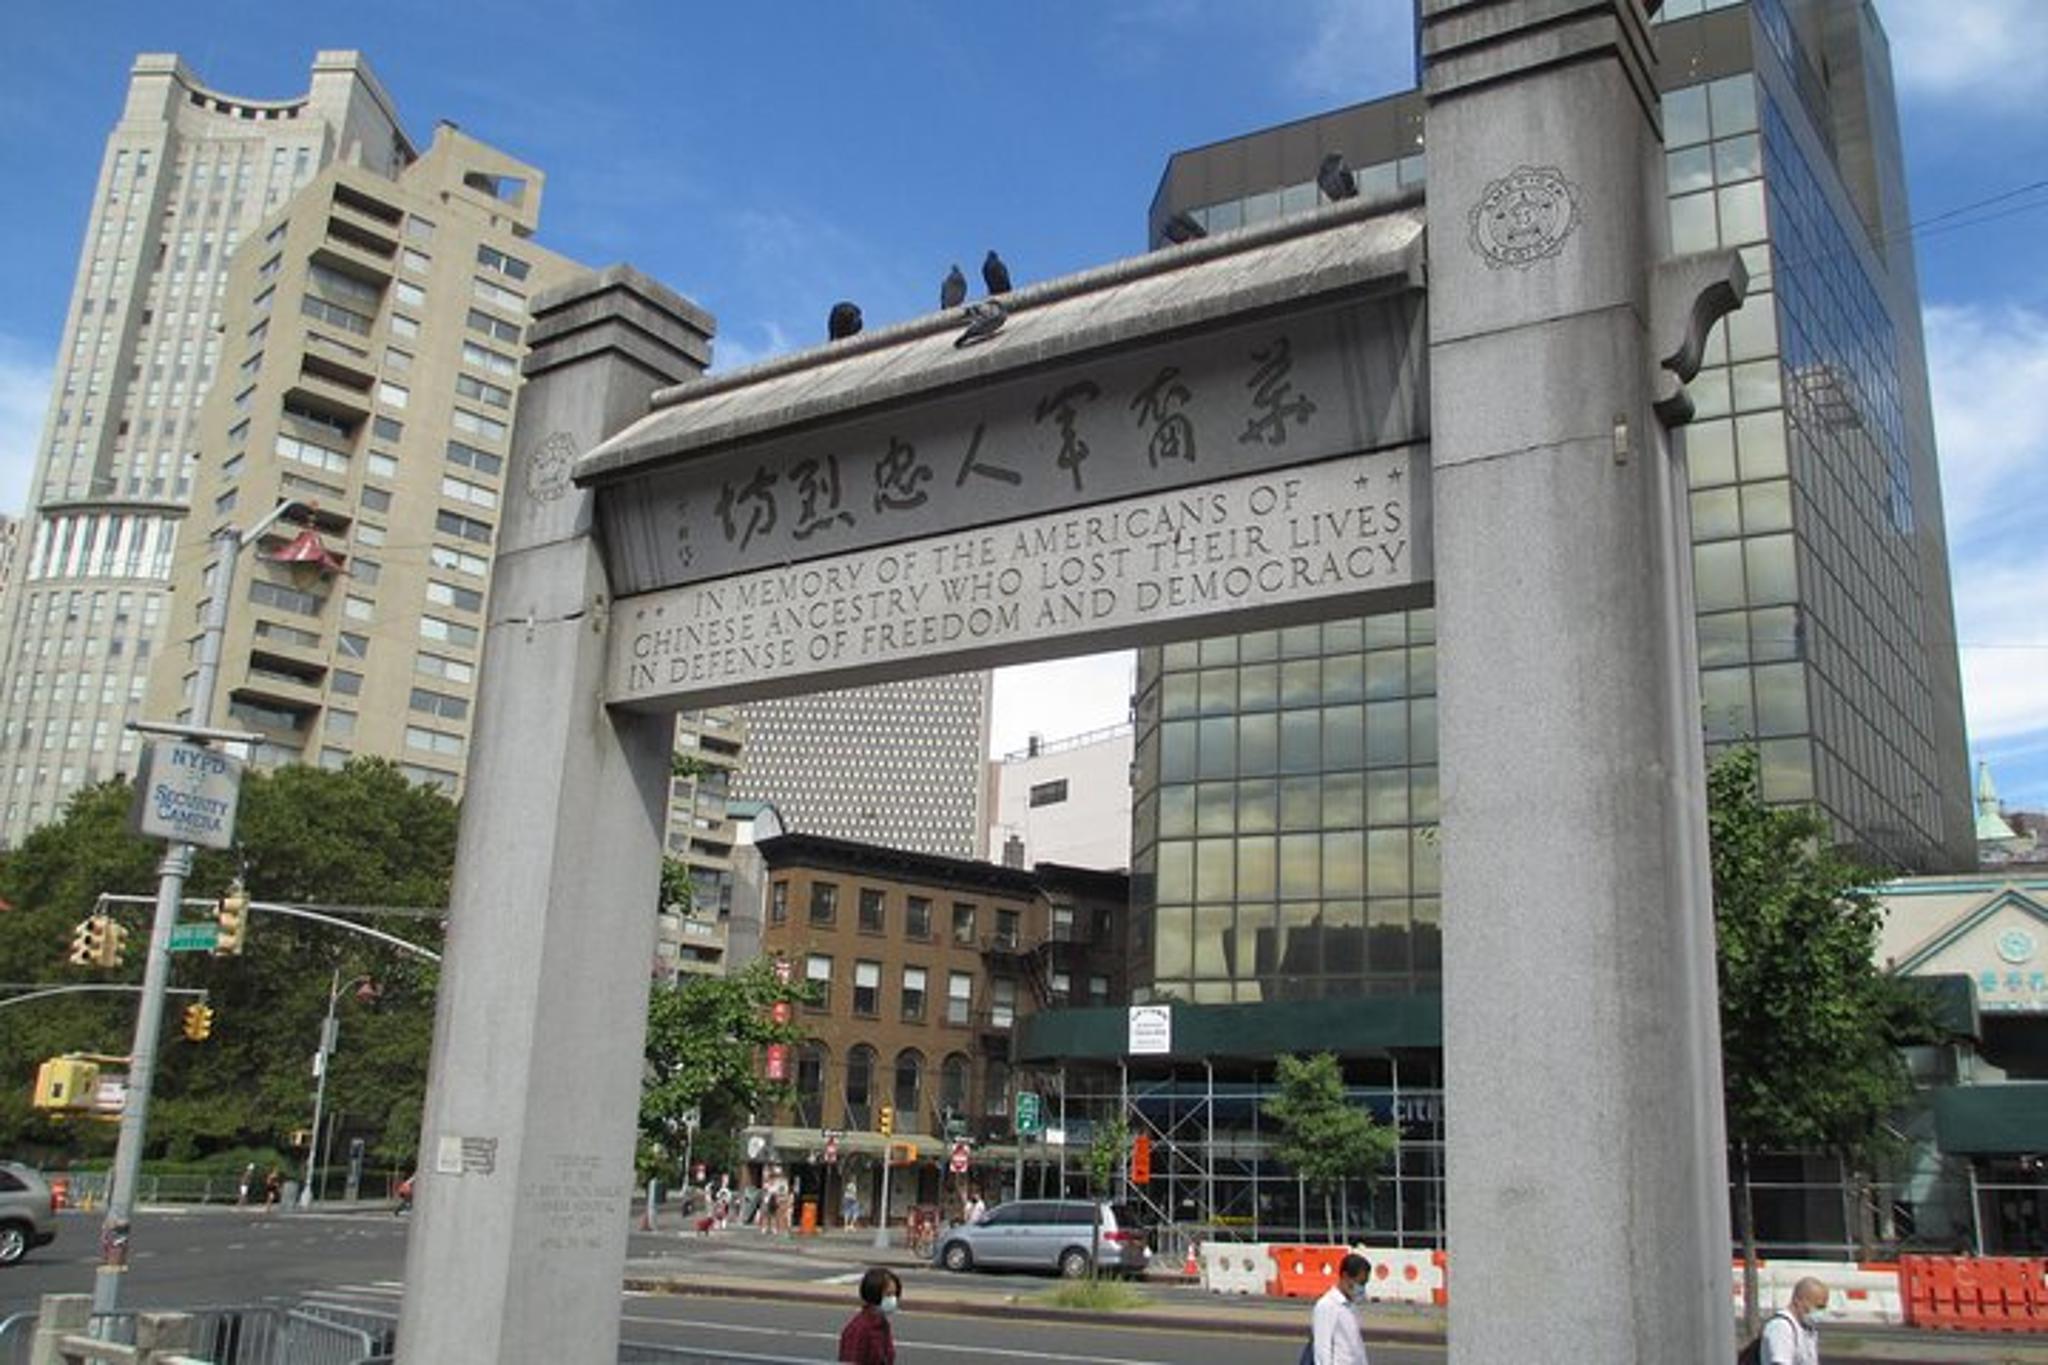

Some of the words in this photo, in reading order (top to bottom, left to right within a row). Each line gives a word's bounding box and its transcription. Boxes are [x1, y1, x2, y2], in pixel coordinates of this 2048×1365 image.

[628, 662, 657, 691] IN
[670, 639, 797, 685] DEFENSE
[808, 631, 848, 662] OF
[861, 603, 1021, 656] FREEDOM
[1034, 589, 1117, 628] AND
[1136, 541, 1407, 613] DEMOCRACY
[634, 614, 756, 660] CHINESE
[765, 583, 929, 638] ANCESTRY
[941, 567, 1023, 604] WHO
[1040, 548, 1131, 590] LOST
[1146, 525, 1273, 572] THEIR
[1289, 501, 1402, 550] LIVES
[694, 590, 727, 618] IN
[736, 561, 865, 611] MEMORY
[876, 550, 917, 583] OF
[932, 537, 997, 575] THE
[1010, 494, 1228, 562] AMERICANS
[1248, 479, 1303, 517] OF
[172, 748, 226, 774] NYPD
